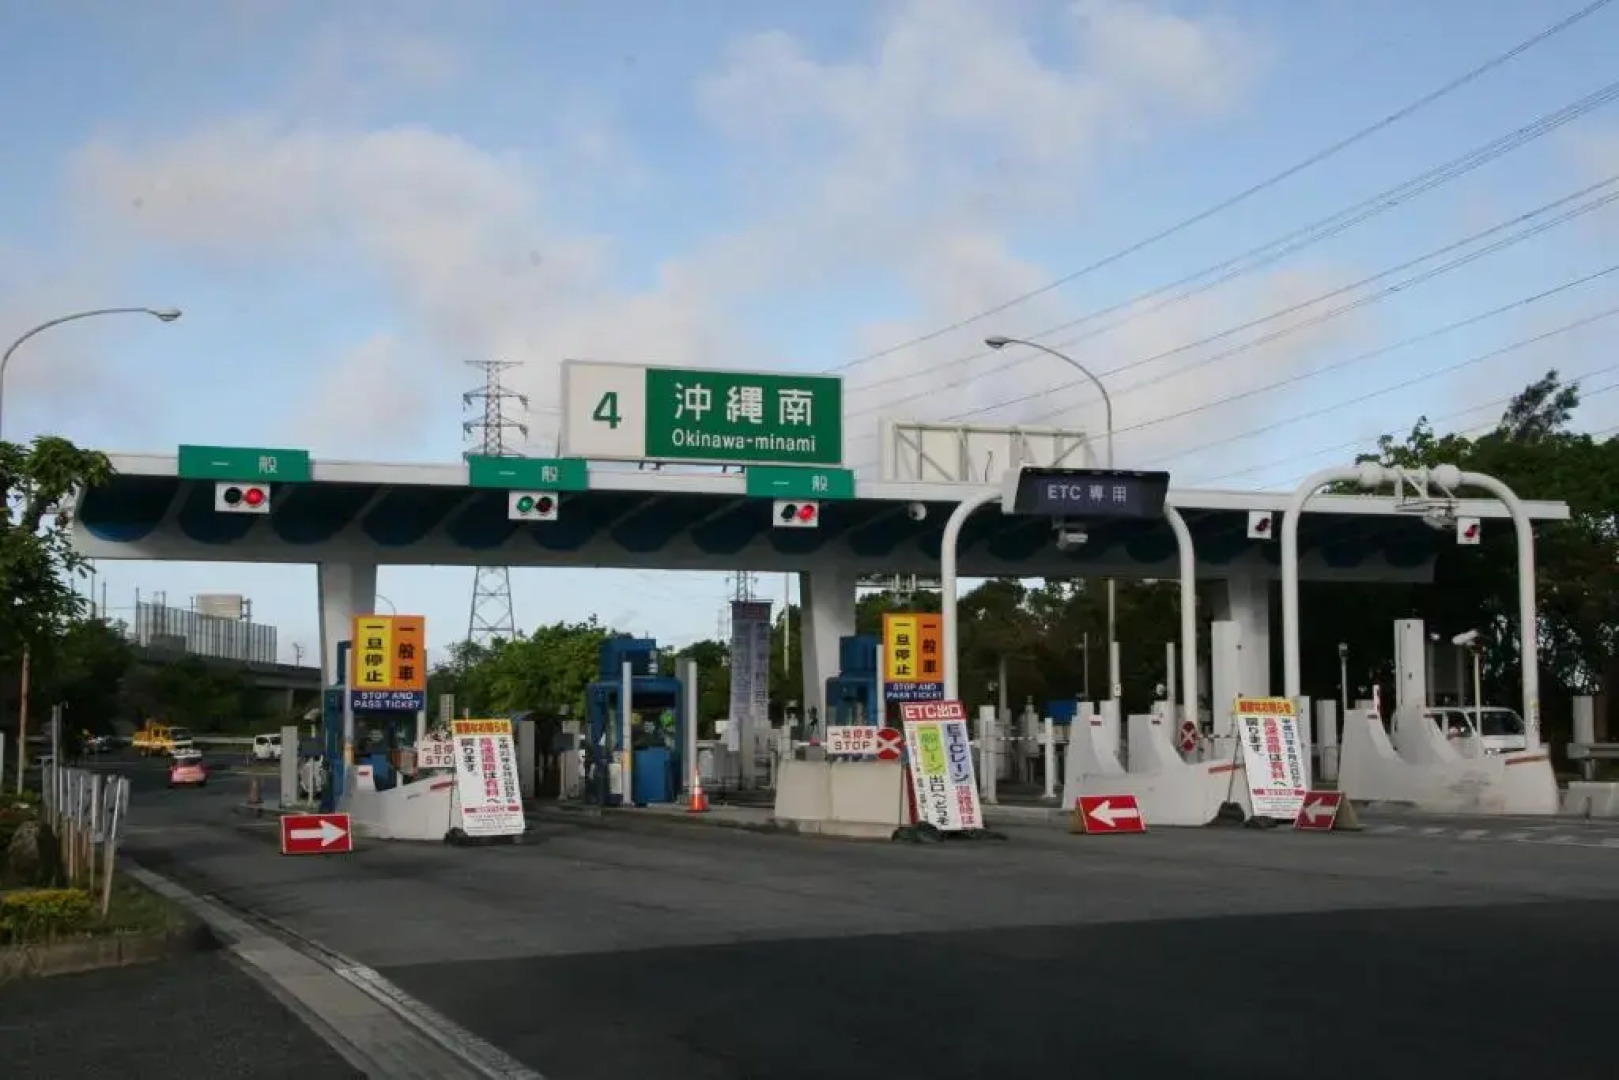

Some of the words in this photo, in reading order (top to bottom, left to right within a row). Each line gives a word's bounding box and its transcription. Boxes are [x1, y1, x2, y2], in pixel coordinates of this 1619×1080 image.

[592, 391, 622, 429] 4
[674, 382, 814, 427] 沖縄南
[671, 428, 816, 453] Okinawa-minami
[211, 455, 278, 475] 一般
[498, 465, 559, 483] 一般
[771, 475, 828, 493] 一般
[1047, 484, 1081, 500] ETC
[1089, 484, 1127, 502] 専用
[365, 625, 384, 683] 一旦停止
[398, 626, 416, 682] 一般車
[894, 622, 912, 677] 一旦停止
[922, 624, 938, 674] 一般車
[361, 692, 389, 700] STOP
[392, 692, 414, 700] AND
[893, 683, 916, 691] STOP
[353, 700, 382, 708] PASS
[385, 700, 420, 708] TICKET
[905, 704, 961, 719] ETC出口
[834, 741, 870, 750] STOP
[425, 755, 455, 765] STO
